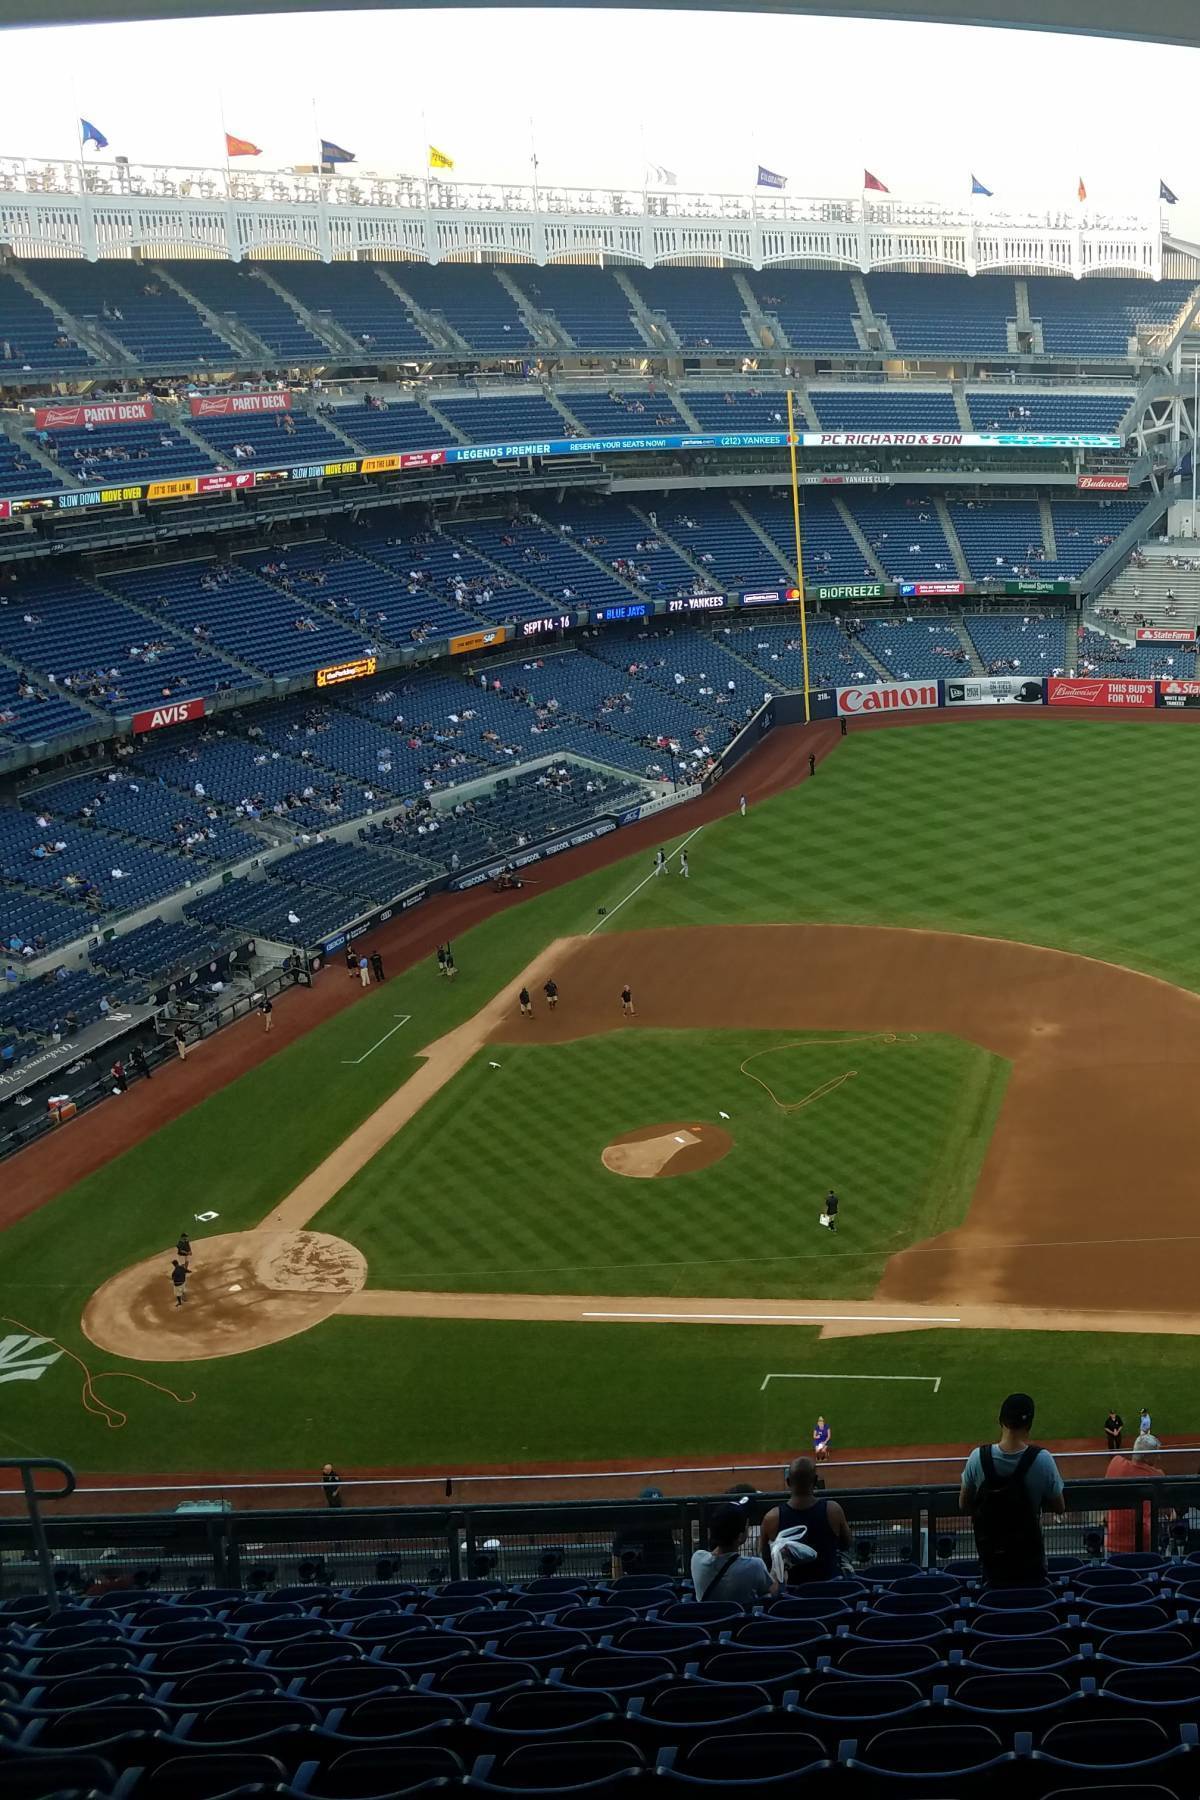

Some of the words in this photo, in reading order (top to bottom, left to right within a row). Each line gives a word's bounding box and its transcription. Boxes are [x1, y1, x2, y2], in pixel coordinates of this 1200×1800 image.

[232, 397, 260, 411] PARTY
[262, 395, 286, 408] DECK
[83, 407, 116, 422] PARTY
[119, 405, 147, 419] DECK
[570, 442, 601, 451] RESERVE
[602, 441, 621, 449] YOUR
[622, 440, 645, 448] SEATS
[646, 439, 666, 447] NOW!
[721, 436, 741, 446] (212)
[743, 436, 781, 444] YANKEES
[820, 435, 843, 446] PC
[844, 434, 917, 446] RICHARD
[918, 434, 930, 445] &
[931, 434, 963, 445] SON
[457, 445, 503, 460] LEGENDS
[505, 443, 551, 457] PREMIER
[292, 467, 308, 479] SLOW
[308, 466, 325, 478] DOWN
[325, 464, 342, 476] MOVE
[342, 462, 357, 474] OVER
[376, 459, 385, 468] THE
[154, 486, 166, 495] IT'S
[168, 484, 177, 494] THE
[1080, 477, 1128, 488] Budweiser
[59, 495, 78, 508] SLOW
[79, 492, 100, 506] DOWN
[102, 489, 122, 502] MOVE
[123, 487, 142, 500] OVER
[669, 600, 682, 612] 212
[689, 596, 724, 609] YANKEES
[606, 607, 625, 620] BLUE
[626, 605, 645, 618] JAYS
[523, 621, 542, 636] SEPT
[543, 618, 553, 632] 14
[560, 616, 570, 628] 16
[483, 632, 495, 643] SAP
[1057, 686, 1098, 697] Budweiser
[1108, 683, 1127, 693] THIS
[1128, 684, 1153, 694] BUD'S
[838, 686, 936, 713] Canon
[1108, 693, 1124, 703] FOR
[1125, 694, 1145, 704] YOU.
[150, 704, 188, 728] AVIS
[326, 936, 345, 951] GEICO
